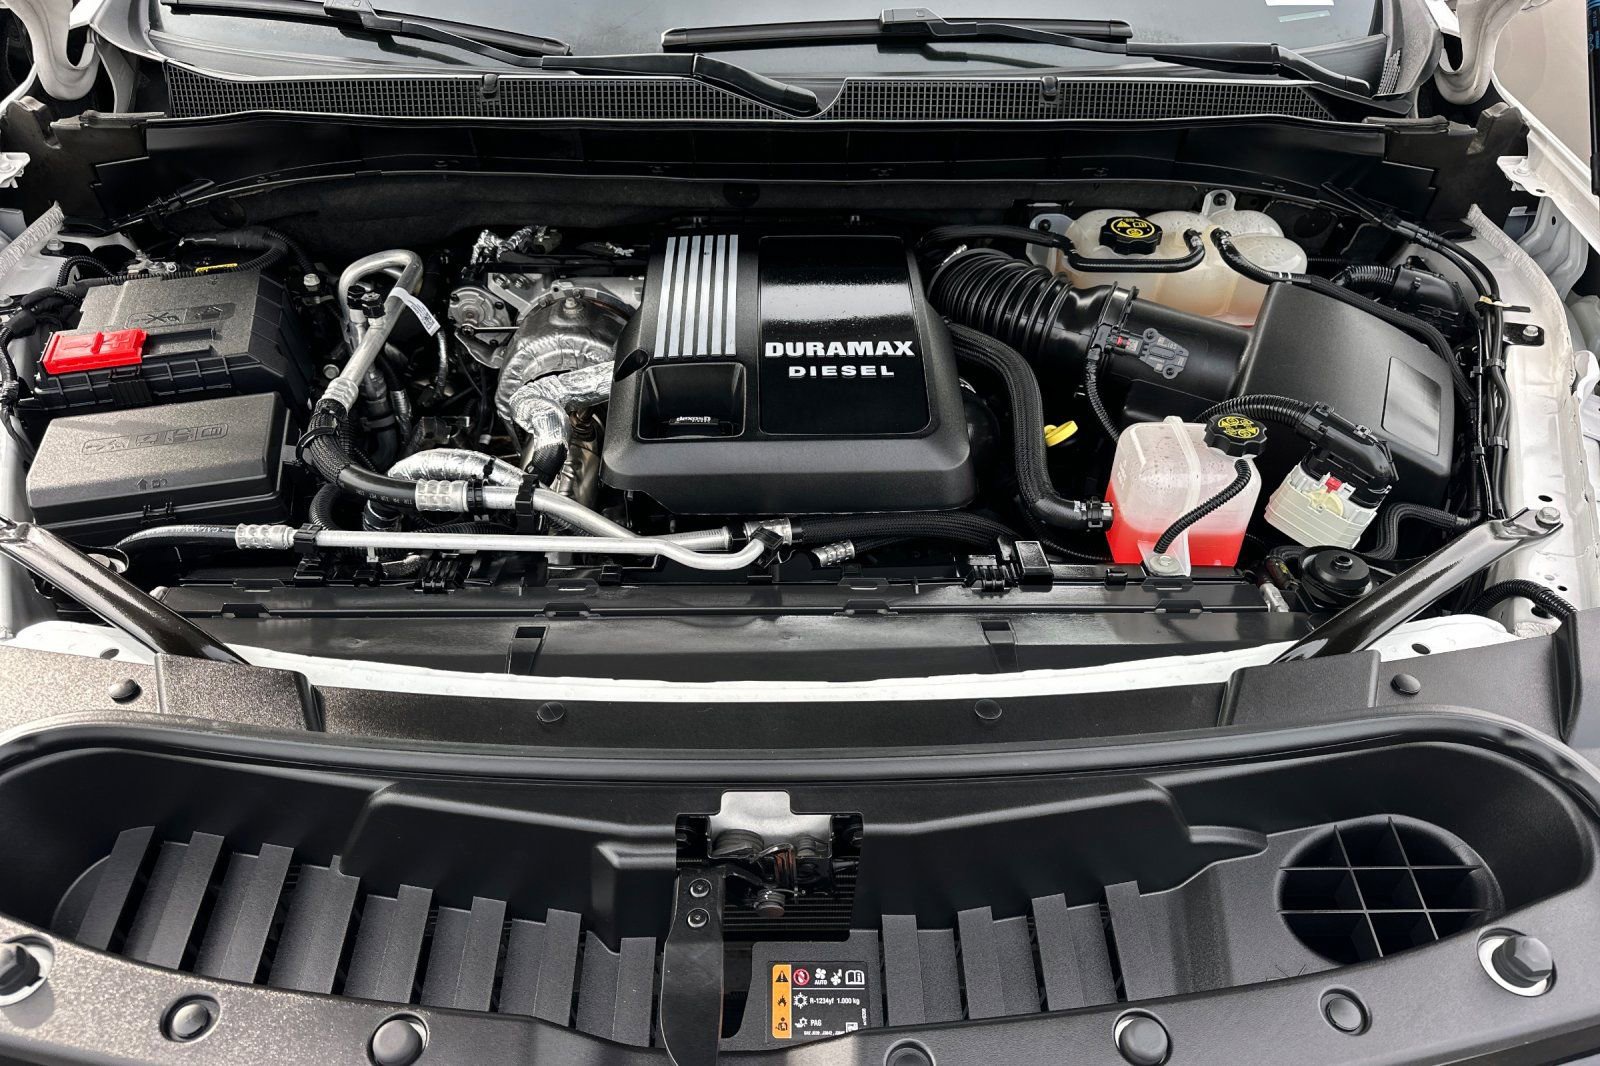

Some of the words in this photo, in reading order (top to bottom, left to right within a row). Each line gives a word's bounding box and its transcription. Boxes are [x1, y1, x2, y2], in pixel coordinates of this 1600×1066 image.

[765, 341, 915, 357] DURAMAX
[788, 365, 895, 378] DIESEL
[809, 997, 834, 1005] R-1234yf
[852, 997, 860, 1005] kg
